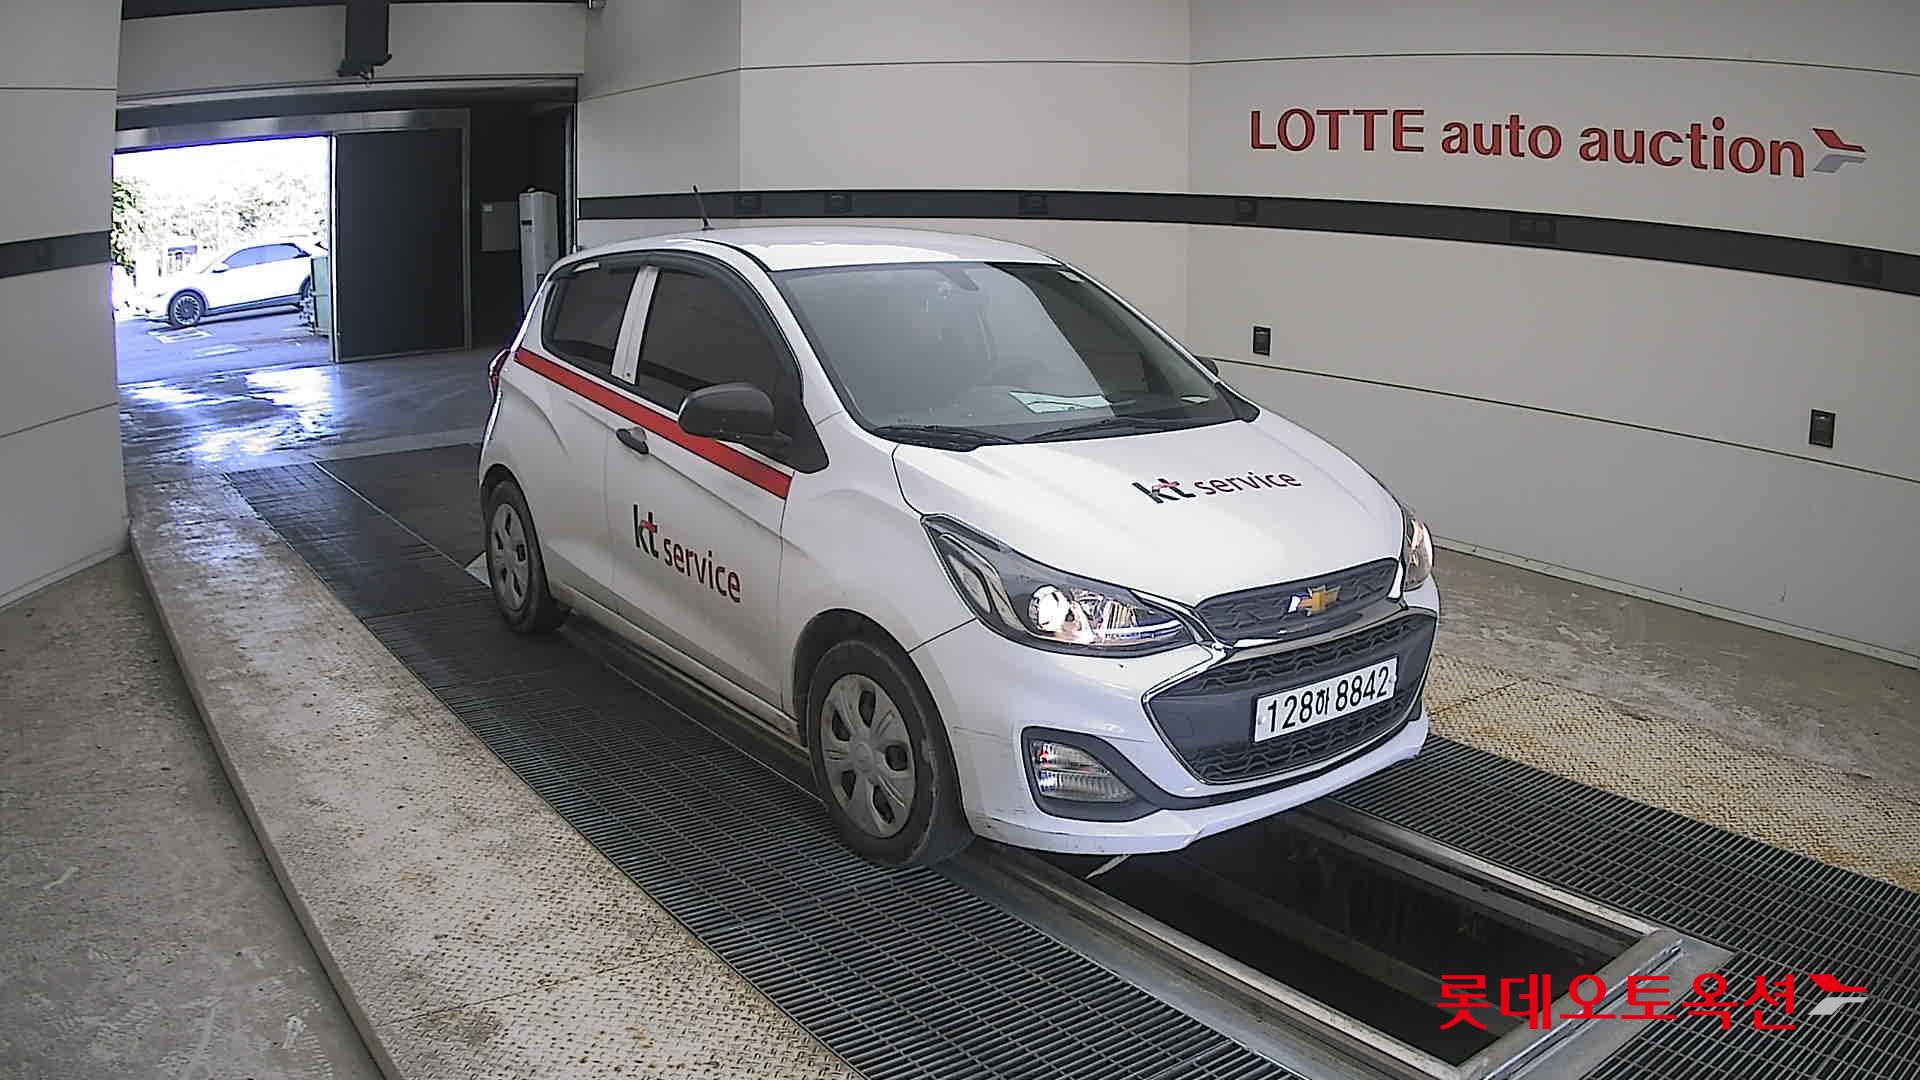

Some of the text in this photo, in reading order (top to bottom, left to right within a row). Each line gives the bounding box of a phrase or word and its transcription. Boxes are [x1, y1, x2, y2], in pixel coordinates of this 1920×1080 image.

[1249, 108, 1806, 178] LOTTE auto auction
[1131, 471, 1303, 504] kt service
[632, 503, 741, 604] kt service
[1267, 666, 1390, 733] 128하 8842
